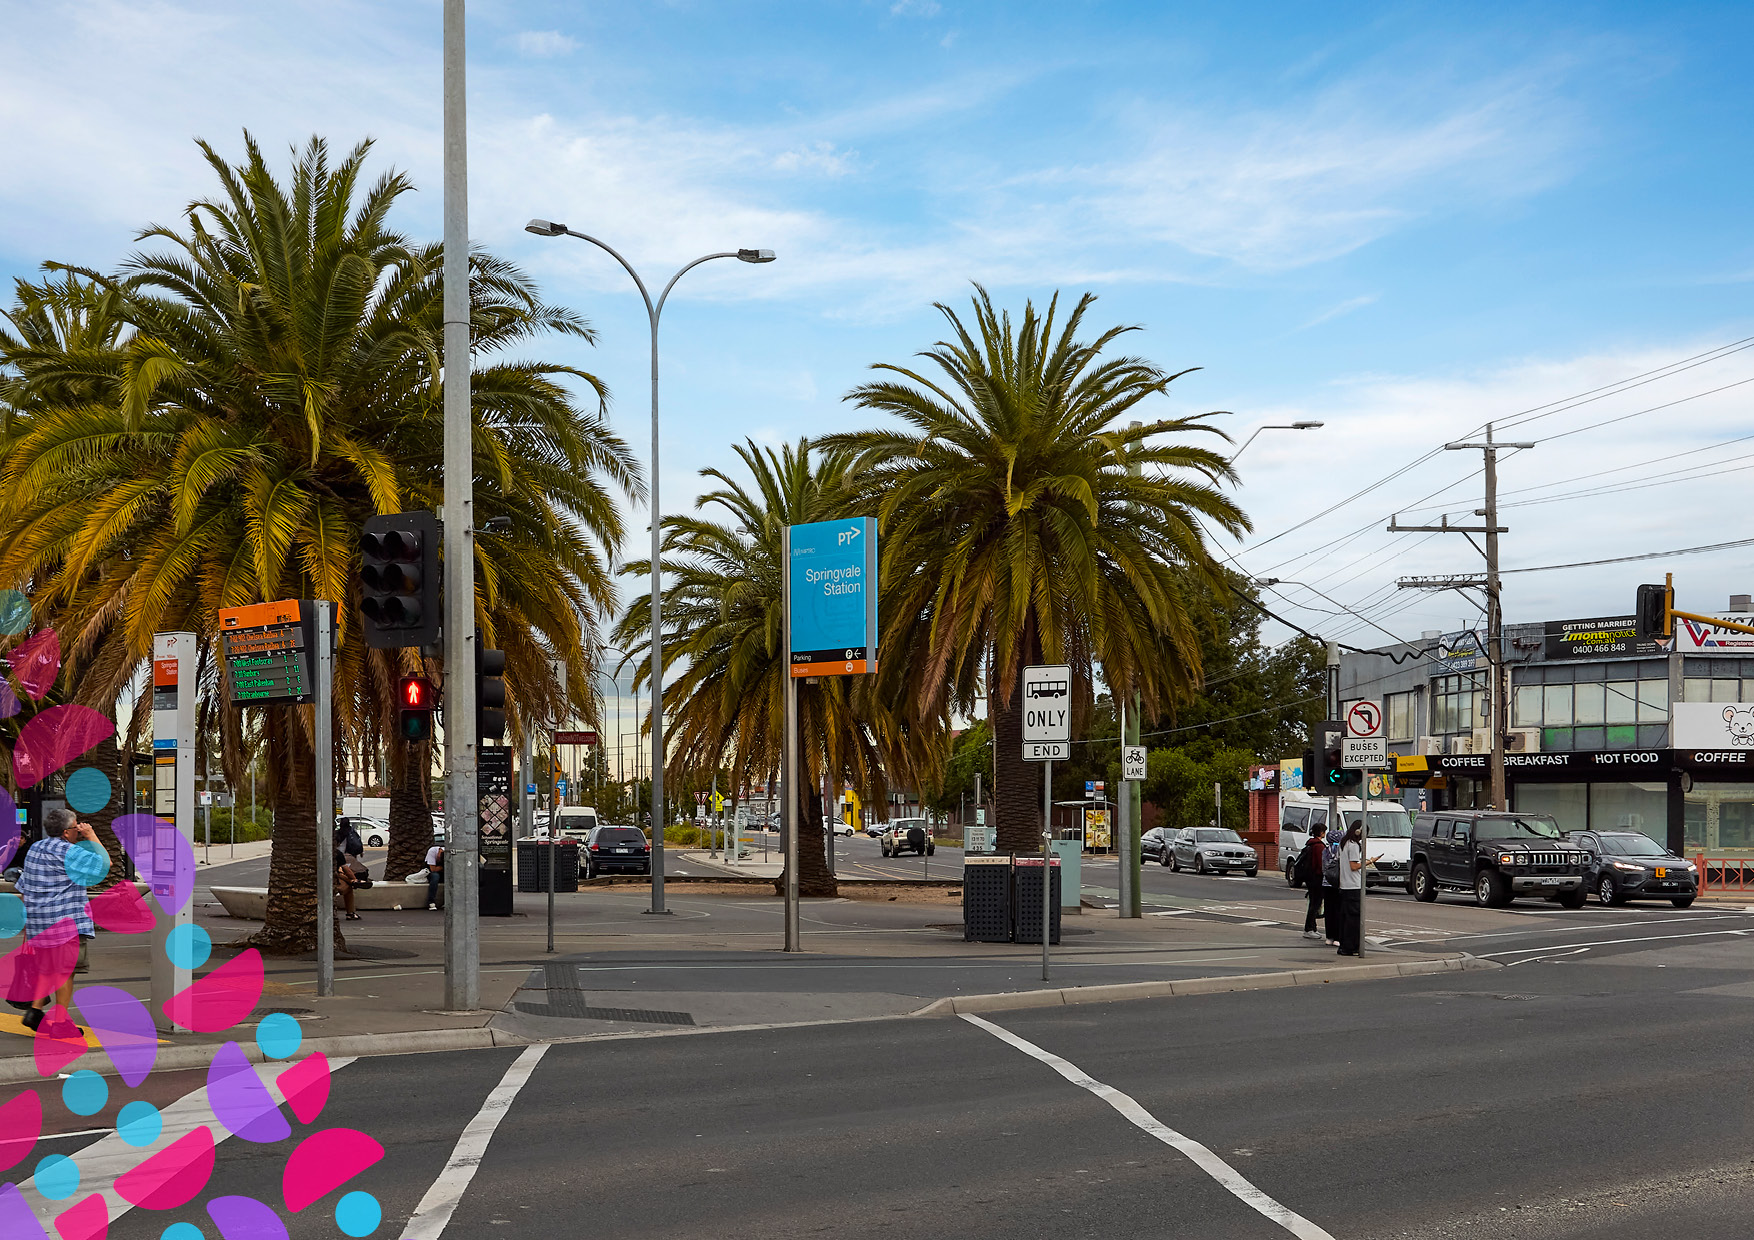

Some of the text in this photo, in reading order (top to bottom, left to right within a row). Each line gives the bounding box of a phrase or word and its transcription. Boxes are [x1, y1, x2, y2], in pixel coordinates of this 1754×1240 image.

[805, 564, 861, 585] Springvale
[823, 582, 861, 596] Station
[1562, 620, 1637, 631] GETTING MARRIED?
[1572, 645, 1593, 654] 0400
[1594, 644, 1609, 653] 466
[1610, 642, 1626, 652] 848
[793, 652, 812, 662] Parking
[1027, 710, 1066, 728] ONLY
[1033, 745, 1061, 756] END
[1350, 743, 1379, 751] BUSES
[1344, 755, 1384, 763] EXCEPTED
[1441, 752, 1747, 767] COFFEE BREAKFAST HOT FOOD COFFEE
[1126, 767, 1143, 776] LANE
